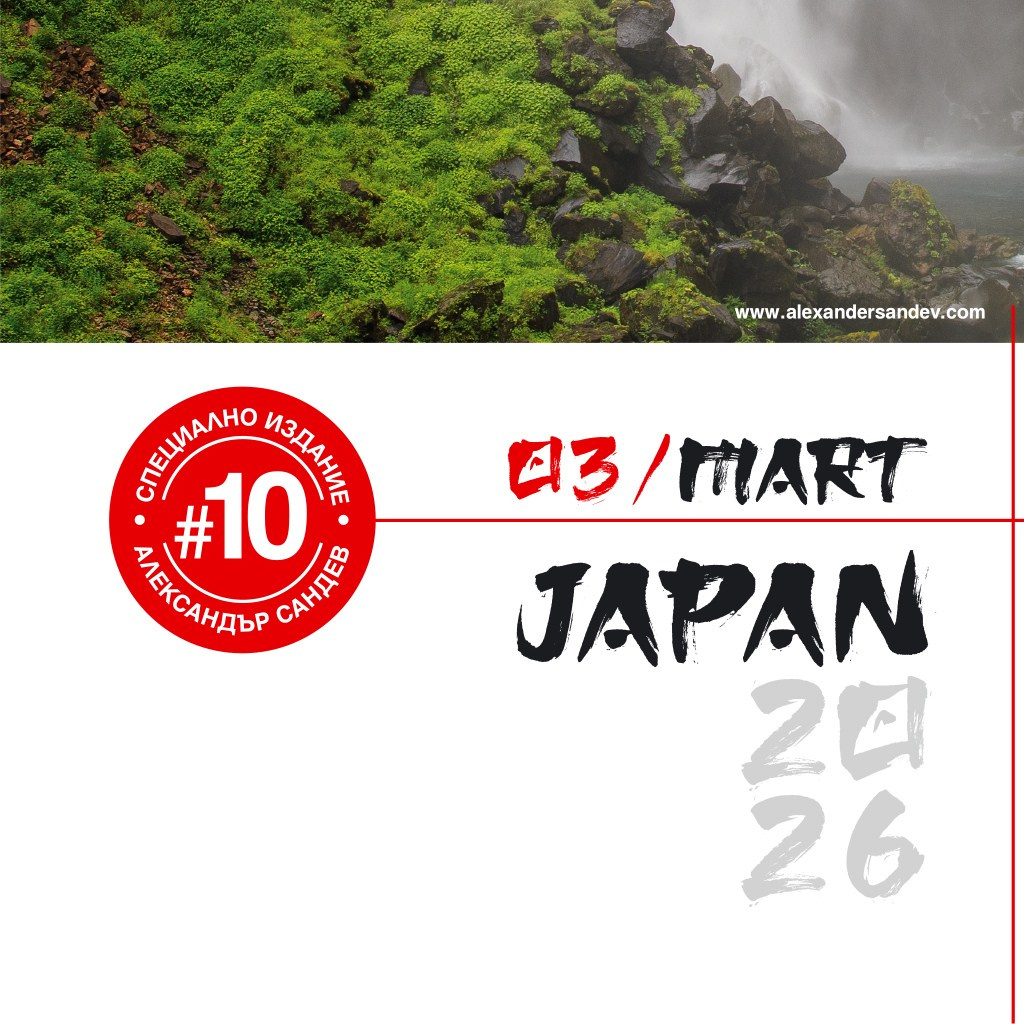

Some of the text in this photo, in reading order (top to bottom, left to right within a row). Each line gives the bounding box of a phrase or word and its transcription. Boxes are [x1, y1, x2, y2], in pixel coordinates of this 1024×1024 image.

[136, 407, 350, 506] СПЕЦИАЛНО ИЗДАНИЕ
[174, 471, 308, 561] #10
[134, 545, 350, 636] АЛЕКСАНДЪР САНДЕВ
[516, 549, 929, 668] JAPAN
[742, 675, 931, 789] 20
[742, 789, 925, 906] 26
